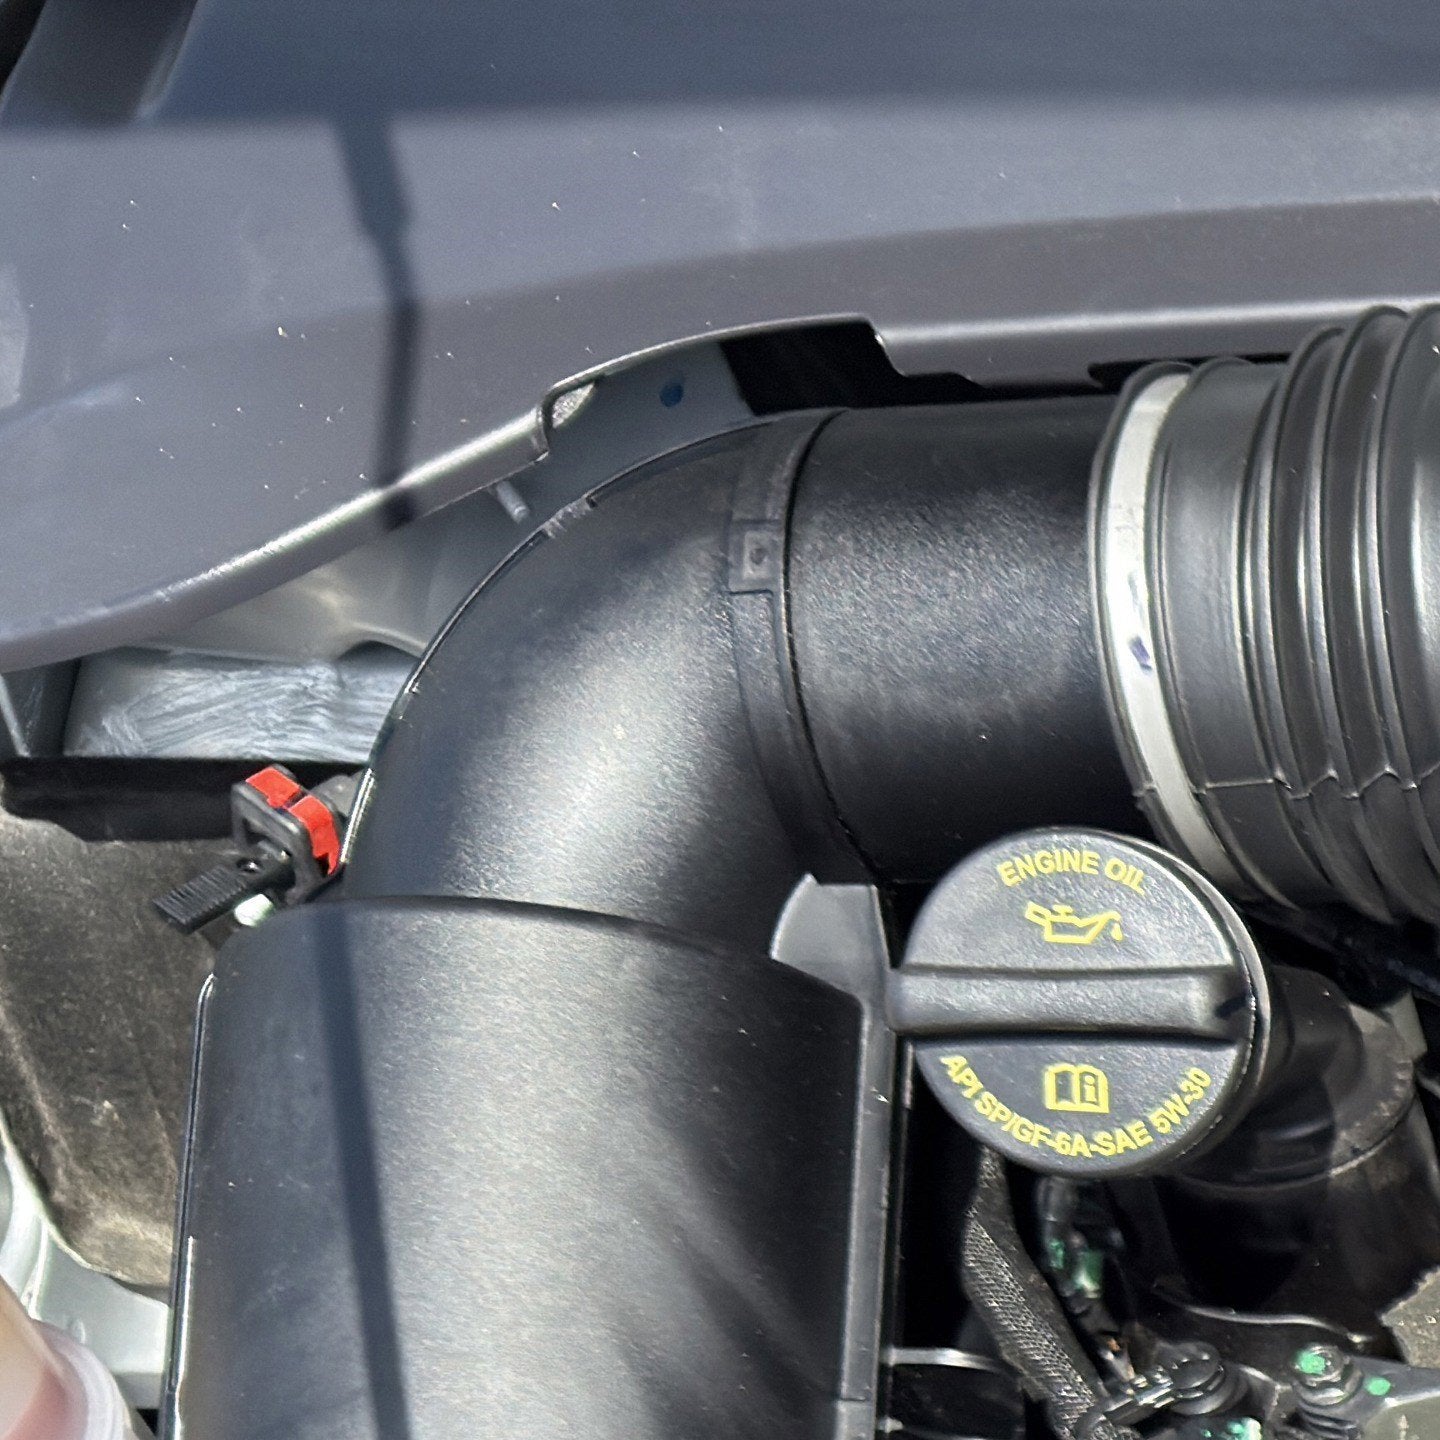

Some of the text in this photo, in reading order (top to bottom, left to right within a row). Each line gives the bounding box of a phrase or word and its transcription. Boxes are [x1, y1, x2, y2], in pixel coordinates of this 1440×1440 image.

[998, 850, 1146, 895] ENGINE OIL
[940, 1055, 978, 1099] API
[1153, 1067, 1213, 1135] 5W-30
